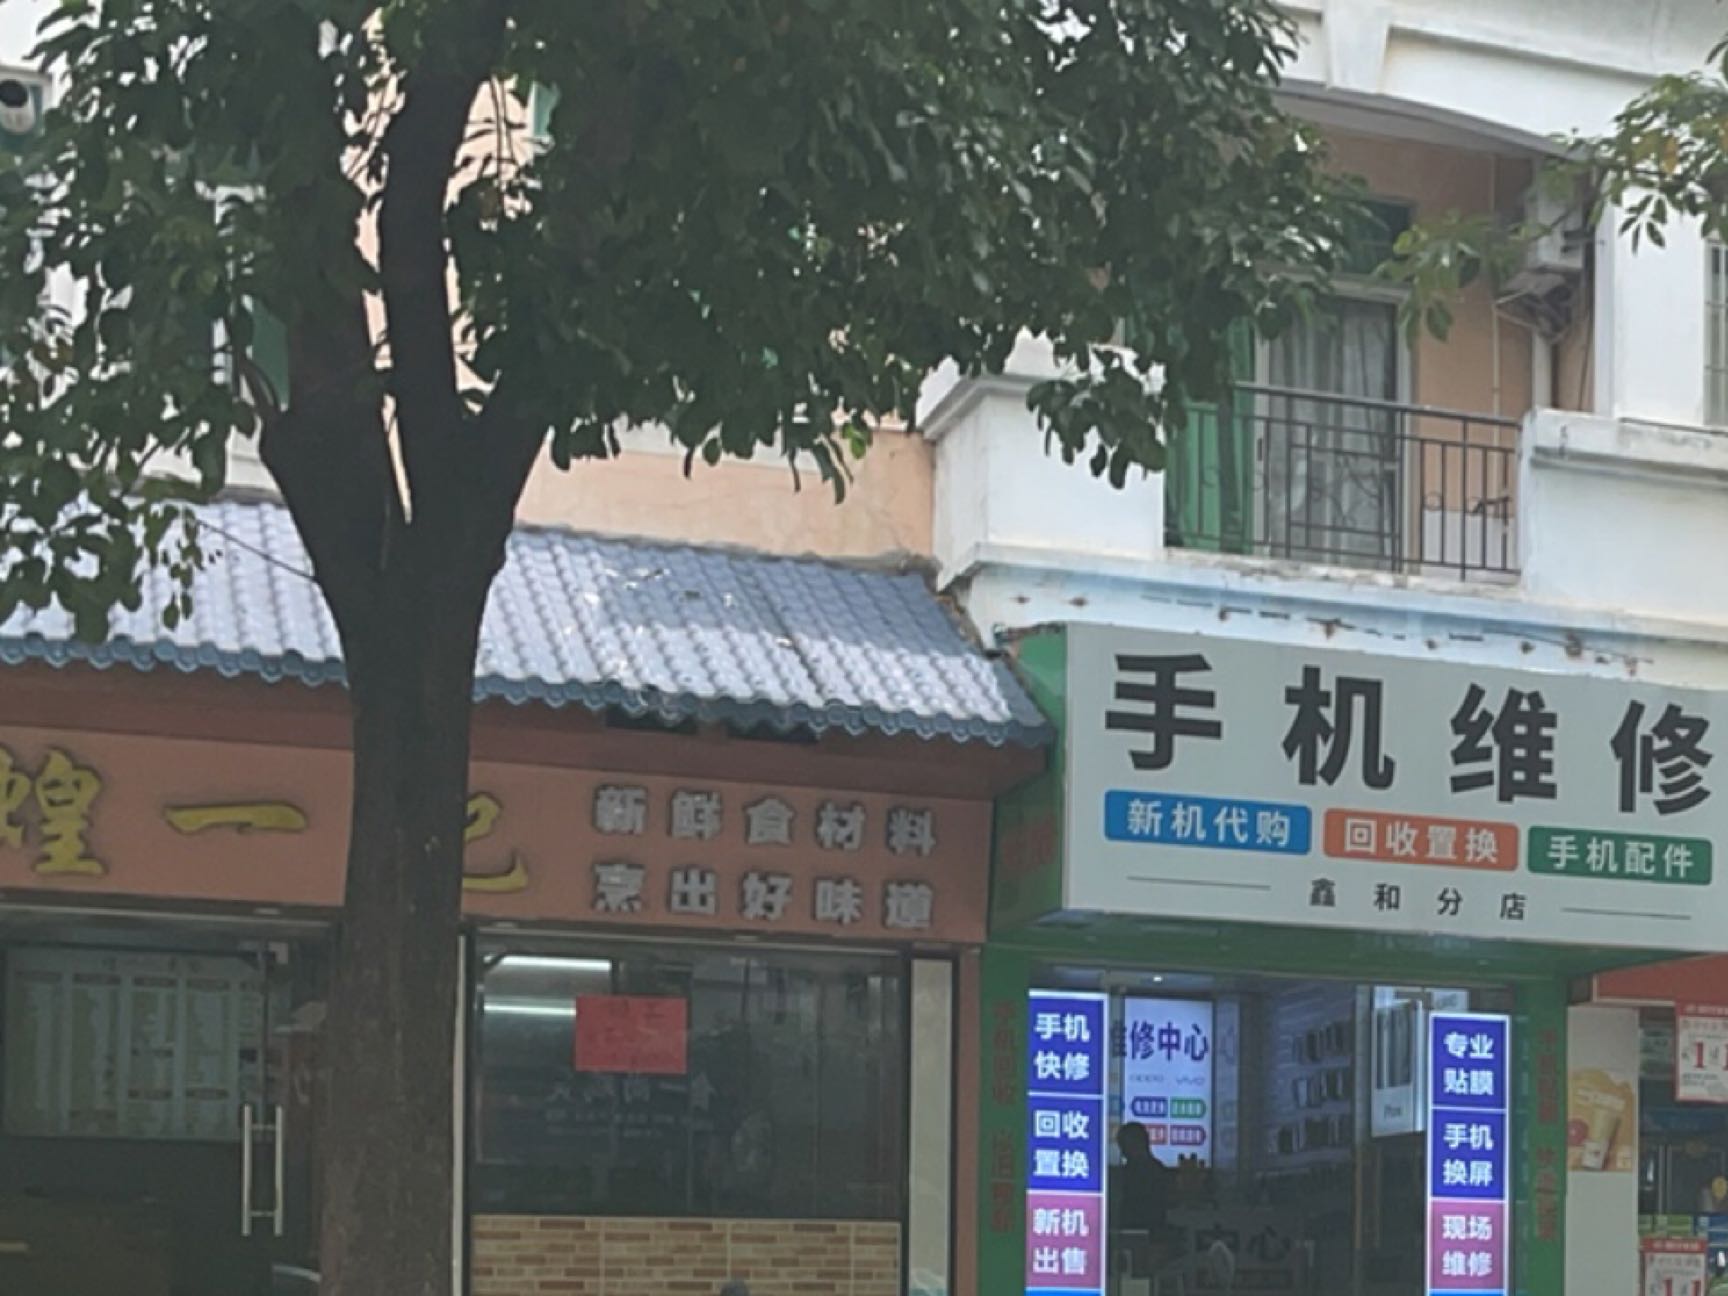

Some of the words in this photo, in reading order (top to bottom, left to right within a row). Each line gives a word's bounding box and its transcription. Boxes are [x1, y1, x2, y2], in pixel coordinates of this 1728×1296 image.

[1105, 655, 1713, 815] 手机维修
[1126, 799, 1292, 847] 新机代购
[1343, 823, 1499, 864] 回收置换
[1546, 836, 1696, 879] 手机配件
[593, 863, 934, 929] 烹出好味道
[1310, 878, 1527, 921] 鑫和分店
[1034, 1012, 1090, 1042] 手机
[1443, 1033, 1495, 1060] 专业
[1034, 1052, 1090, 1081] 快修
[1443, 1069, 1495, 1096] 贴膜
[1033, 1110, 1090, 1139] 回收
[1443, 1123, 1495, 1150] 手机
[1032, 1149, 1090, 1179] 置换
[1442, 1159, 1494, 1186] 换屏
[1032, 1208, 1089, 1237] 新机
[1442, 1215, 1493, 1240] 现场
[1031, 1247, 1087, 1275] 出售
[1442, 1251, 1493, 1277] 维修
